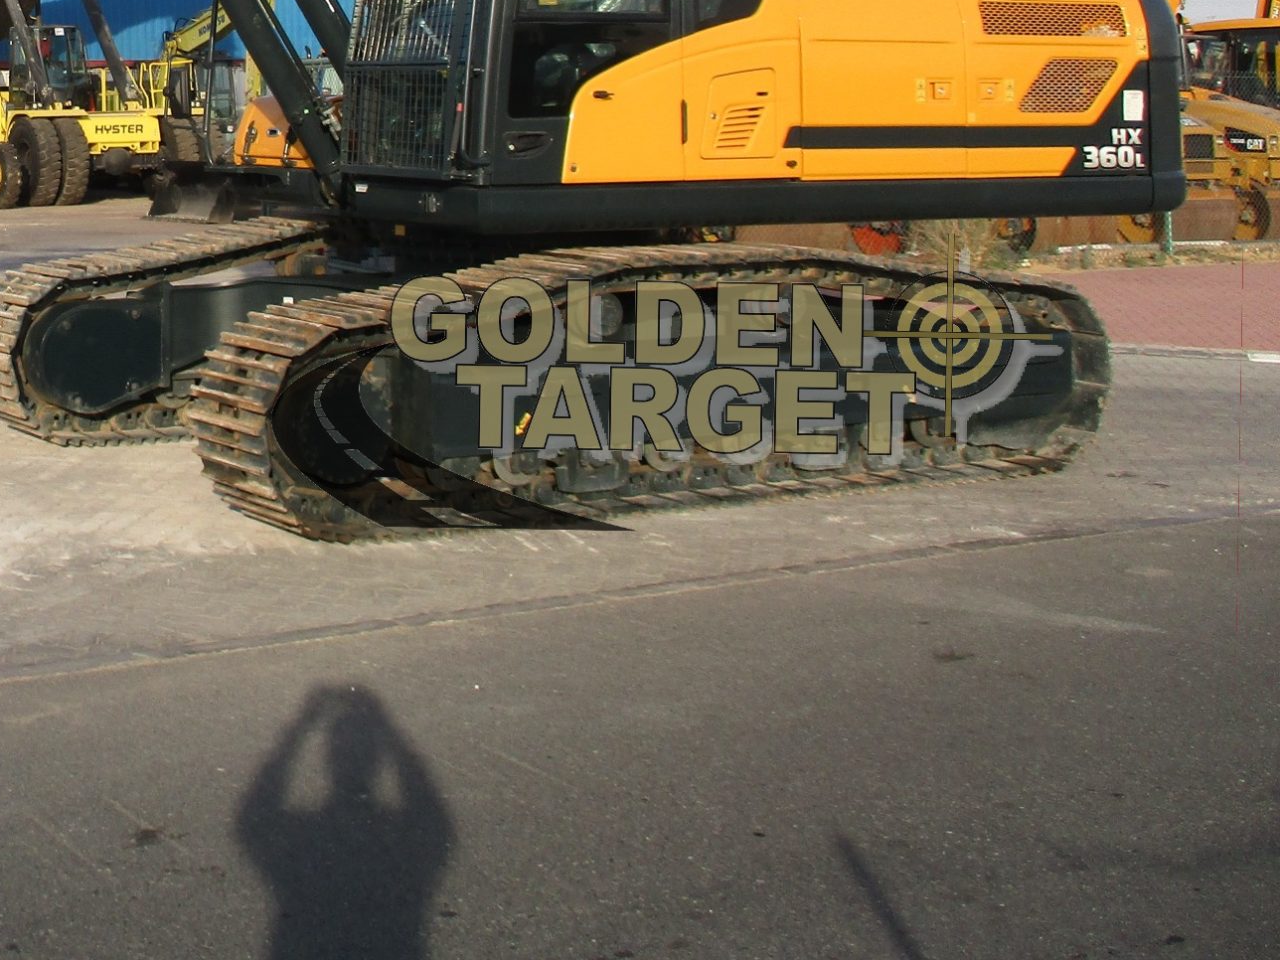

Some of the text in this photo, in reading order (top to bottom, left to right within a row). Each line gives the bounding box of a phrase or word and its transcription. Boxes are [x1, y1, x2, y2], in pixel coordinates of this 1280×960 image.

[94, 124, 144, 134] HYSTER
[1111, 128, 1142, 145] HX
[1246, 138, 1265, 150] CAT
[1083, 145, 1145, 168] 360L
